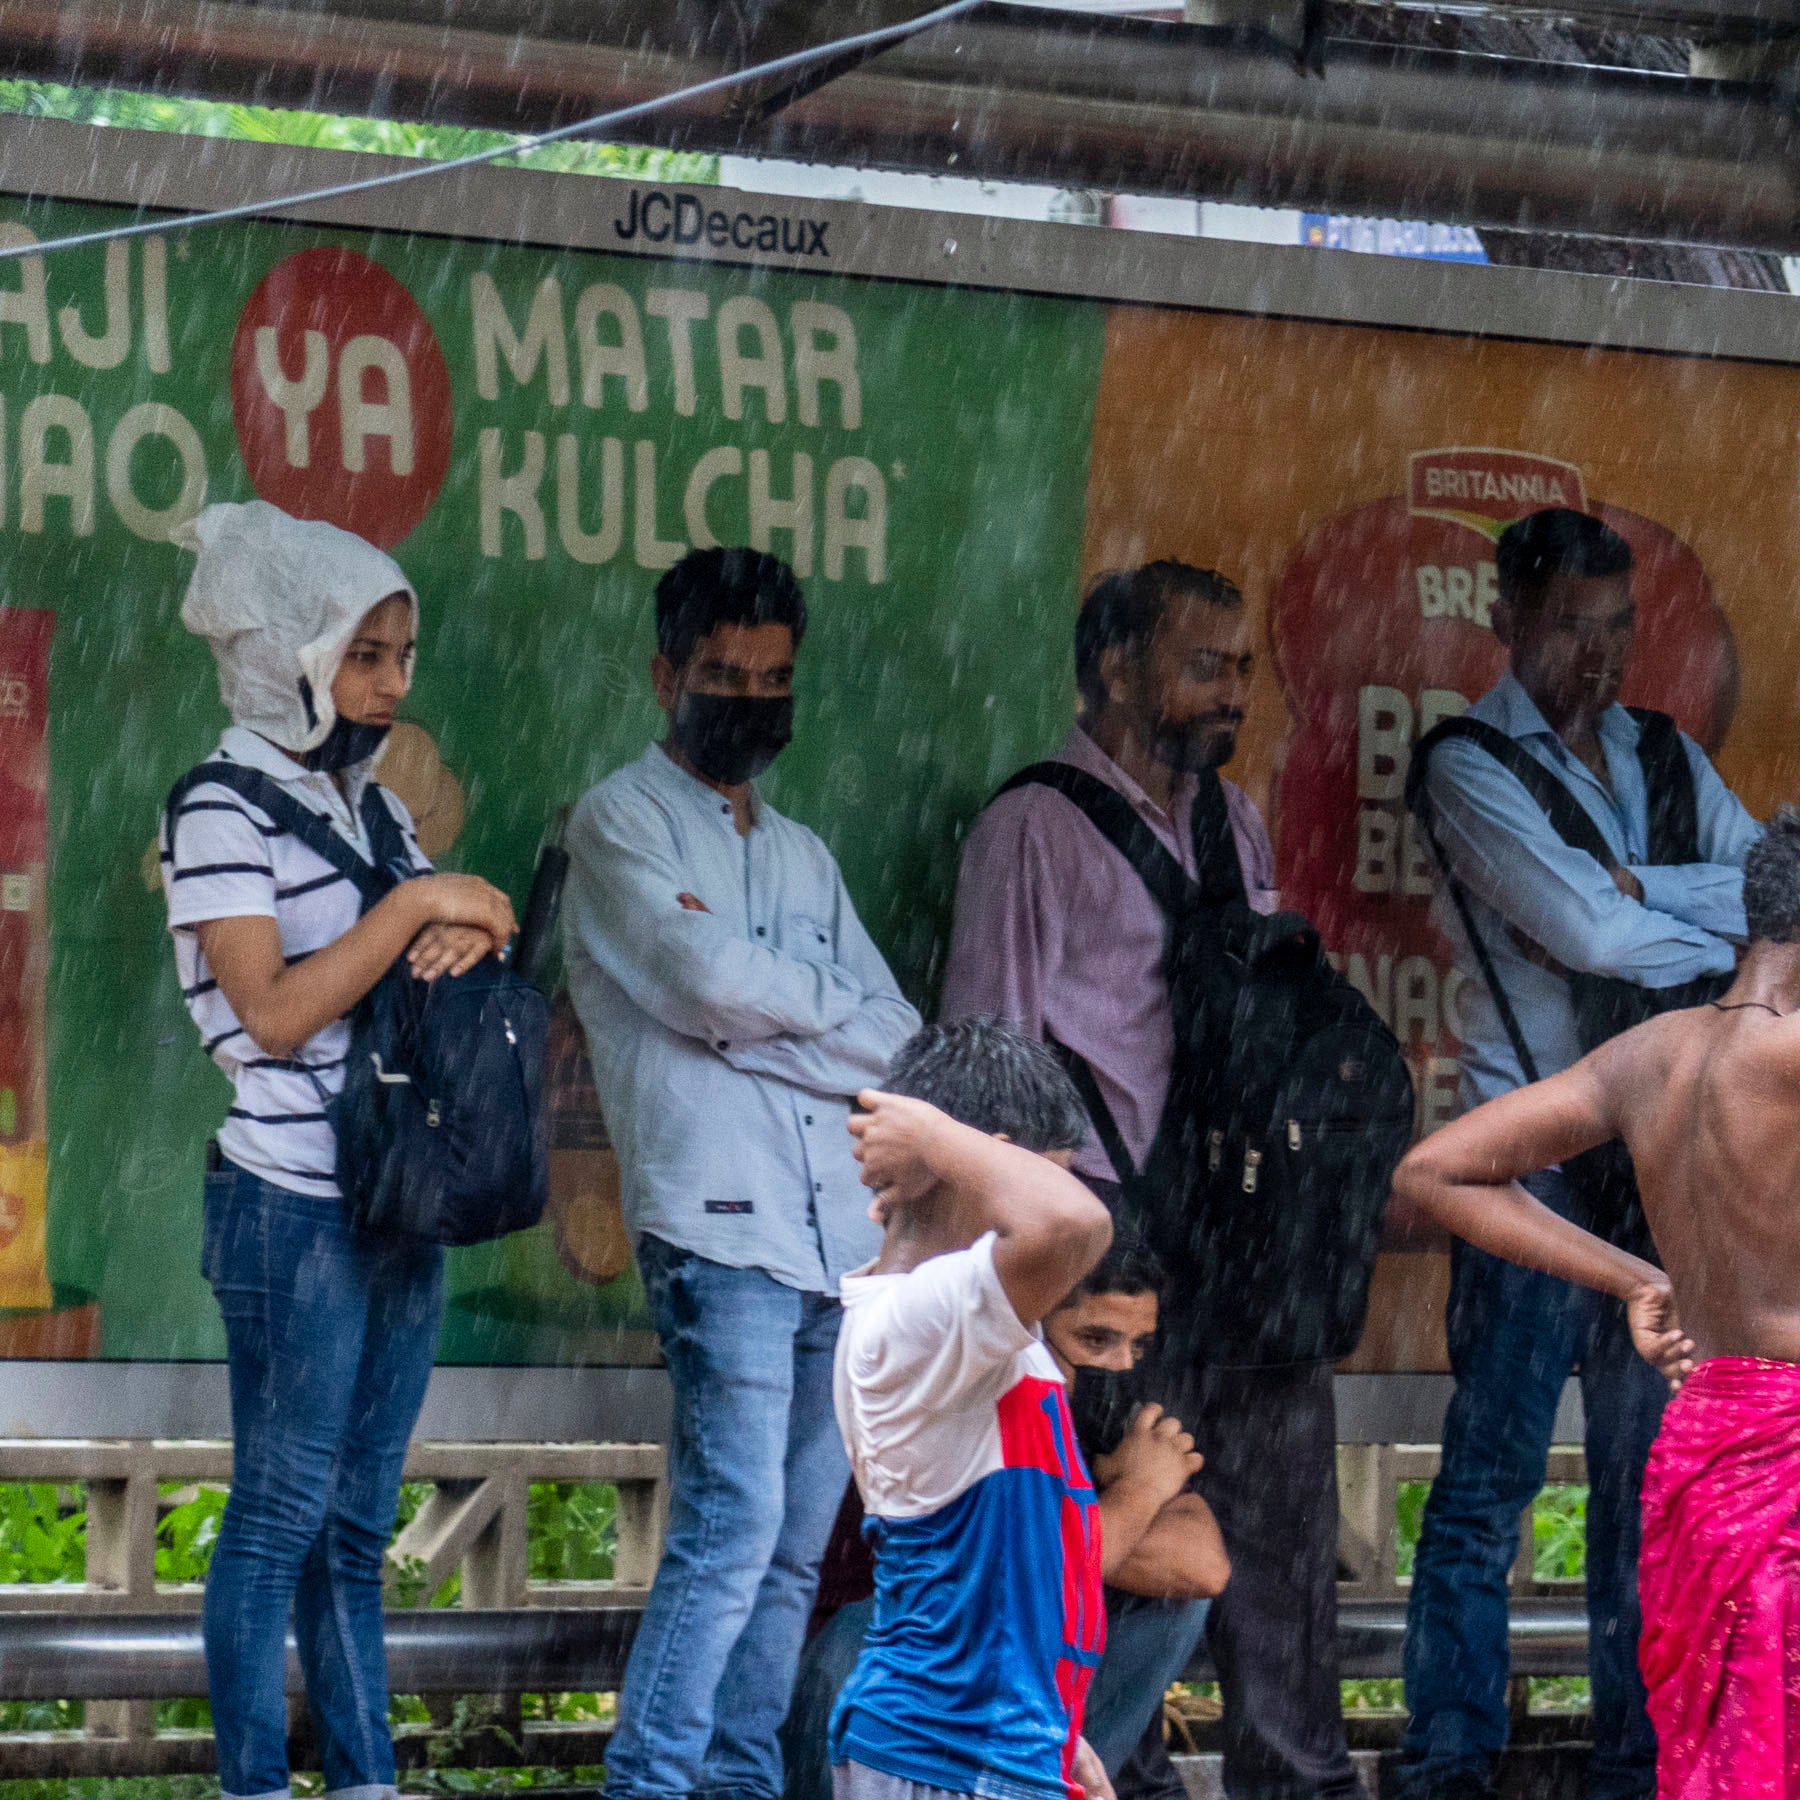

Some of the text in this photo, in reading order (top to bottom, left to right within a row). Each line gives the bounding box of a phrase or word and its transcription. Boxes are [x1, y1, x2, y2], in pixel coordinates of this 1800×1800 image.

[614, 189, 830, 258] JCDecaux
[254, 326, 414, 476] YA
[470, 272, 863, 430] MATAR
[0, 392, 209, 542] AO
[1423, 465, 1568, 506] BRITANNIA
